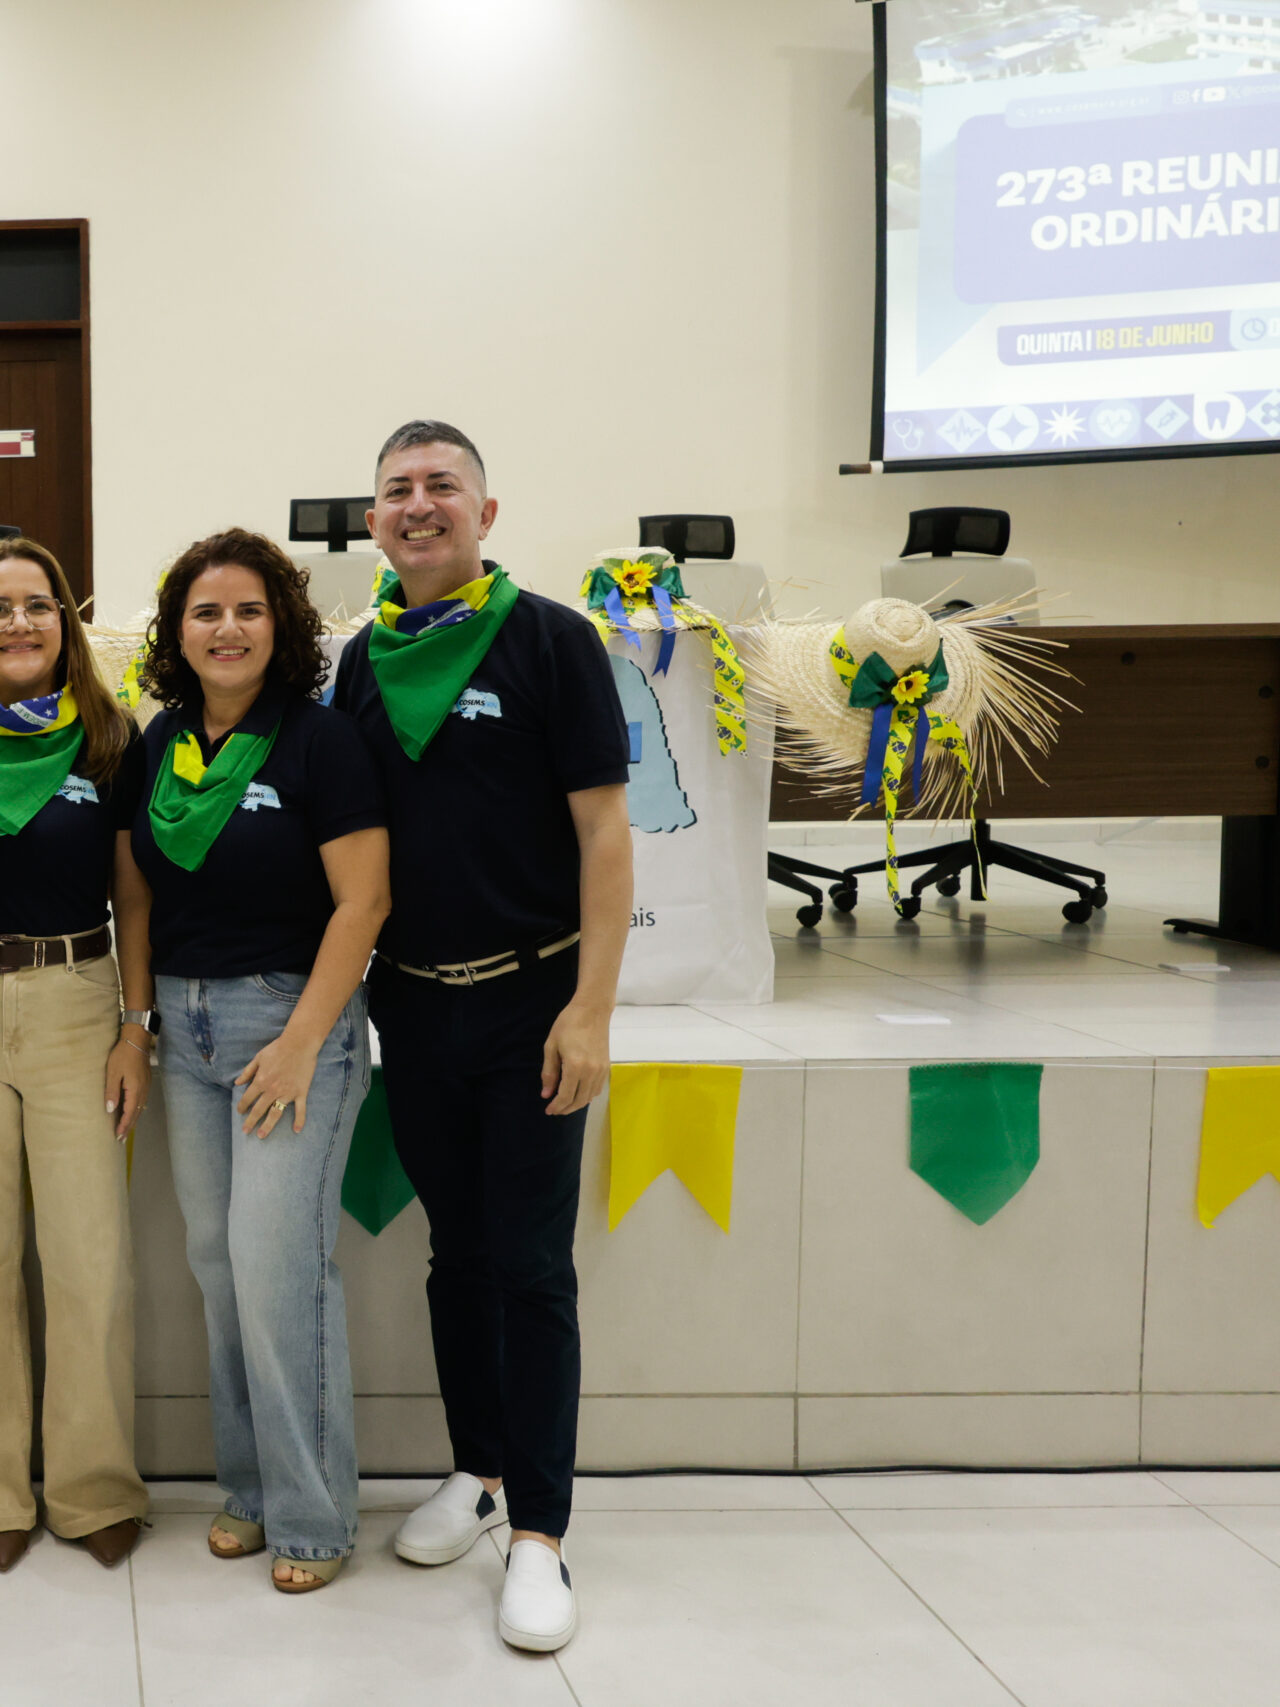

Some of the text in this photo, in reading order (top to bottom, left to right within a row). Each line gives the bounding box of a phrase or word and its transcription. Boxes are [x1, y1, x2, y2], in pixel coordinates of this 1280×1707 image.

[1122, 148, 1280, 197] REUNI
[1016, 331, 1083, 355] QUINTA
[1096, 327, 1115, 350] 18
[1119, 326, 1144, 348] DE
[1145, 321, 1214, 347] JUNHO
[630, 907, 656, 928] ais
